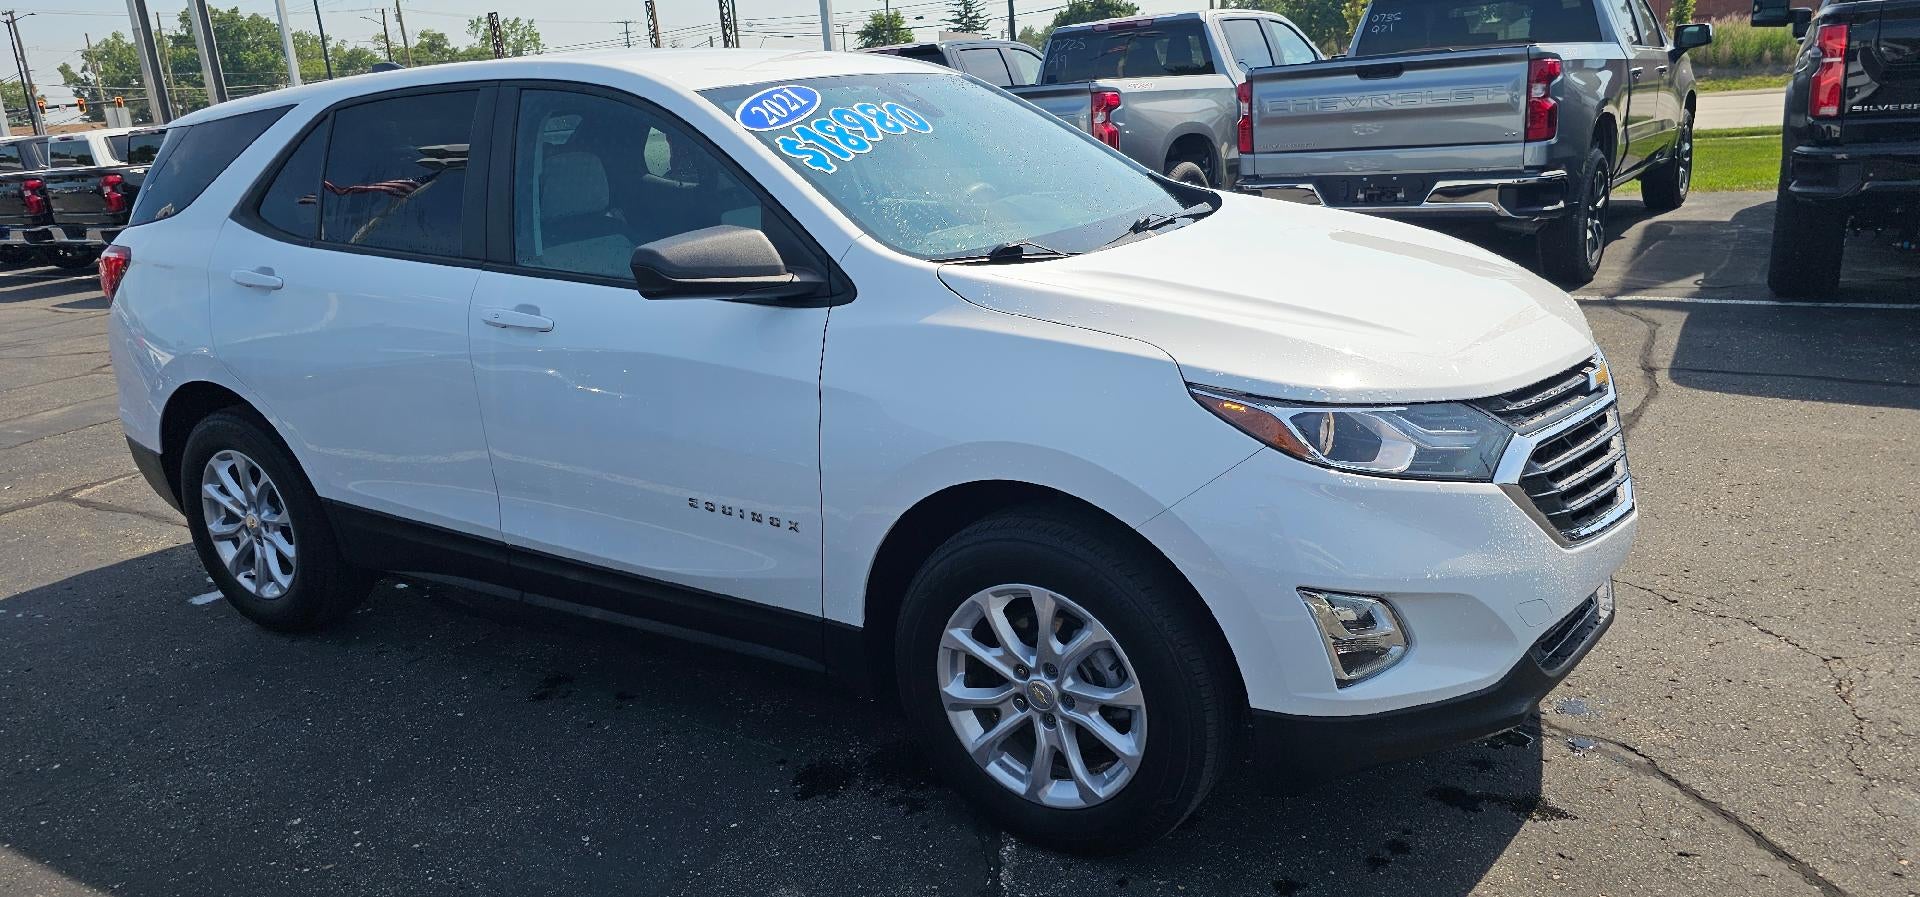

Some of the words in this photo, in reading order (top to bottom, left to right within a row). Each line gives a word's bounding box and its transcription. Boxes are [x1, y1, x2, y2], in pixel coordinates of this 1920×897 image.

[751, 88, 810, 126] 2021
[1267, 84, 1505, 114] CHEVROLET
[775, 102, 933, 174] $18980
[688, 497, 800, 533] EQUINOX
